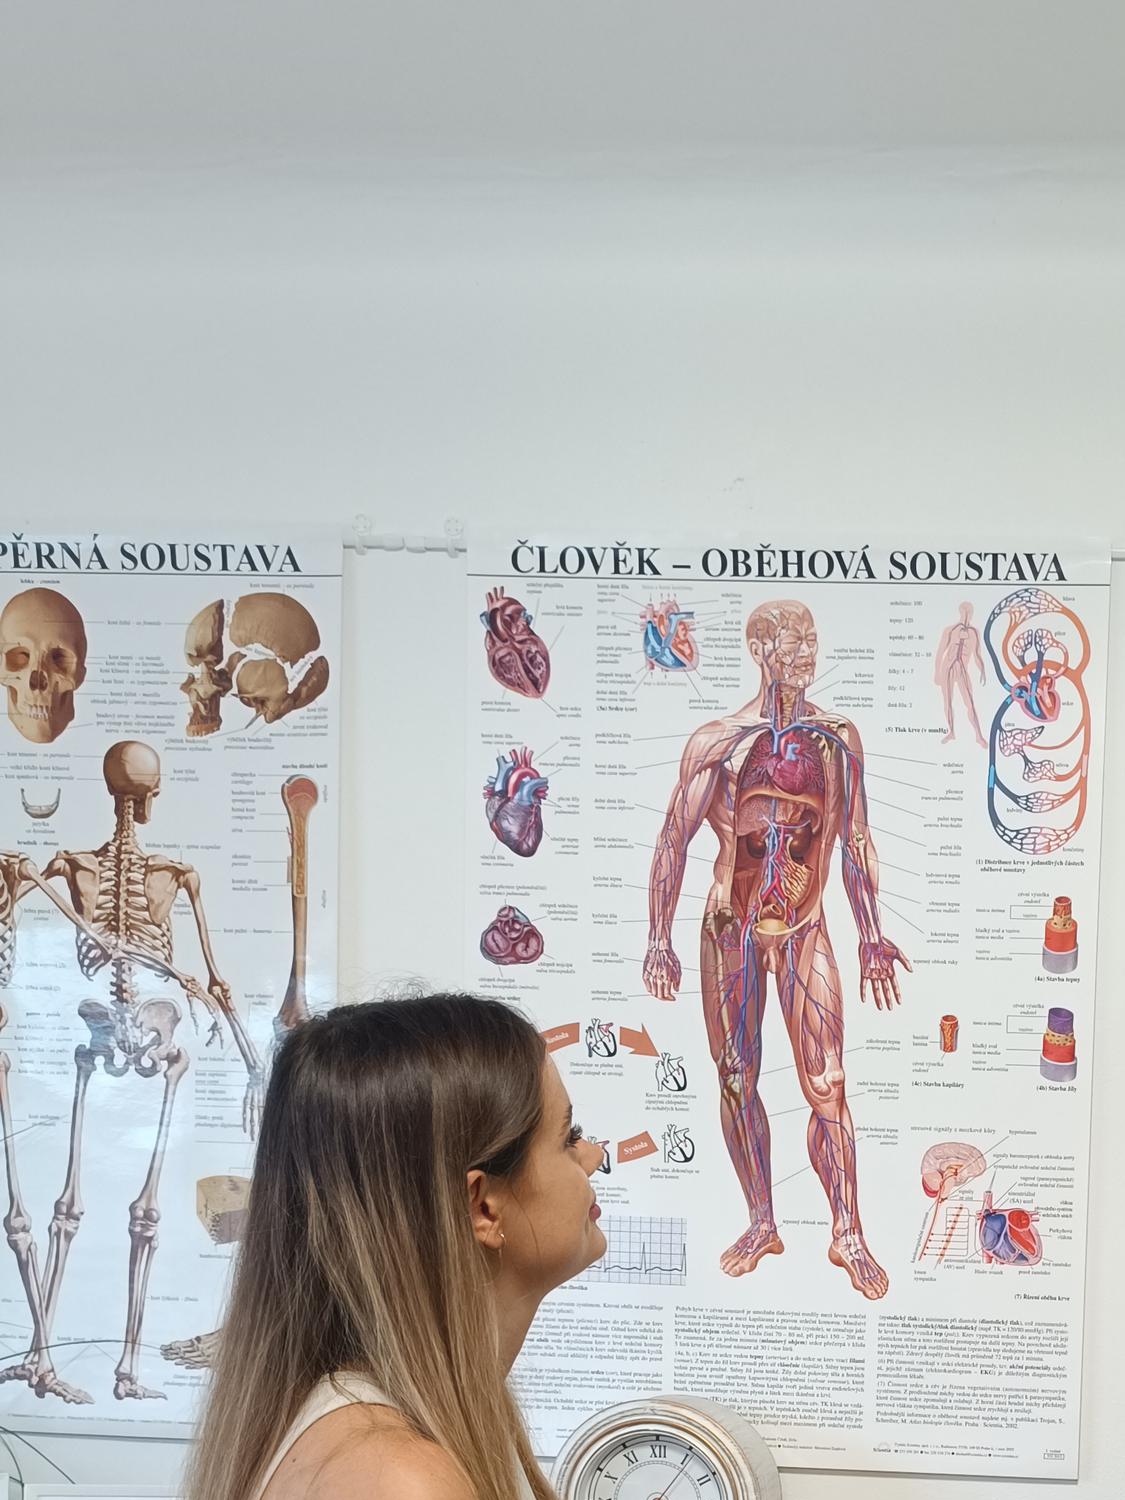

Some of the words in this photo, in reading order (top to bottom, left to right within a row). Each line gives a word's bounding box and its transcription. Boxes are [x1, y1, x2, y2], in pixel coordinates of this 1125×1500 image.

[120, 543, 302, 573] SOUSTAVA
[511, 539, 662, 577] ČLOVĚK
[701, 543, 877, 580] OBĚHOVÁ
[889, 550, 1067, 582] SOUSTAVA
[650, 1445, 667, 1458] XII
[623, 1450, 639, 1467] XI
[680, 1453, 689, 1465] I
[604, 1472, 618, 1484] X
[697, 1474, 711, 1487] II
